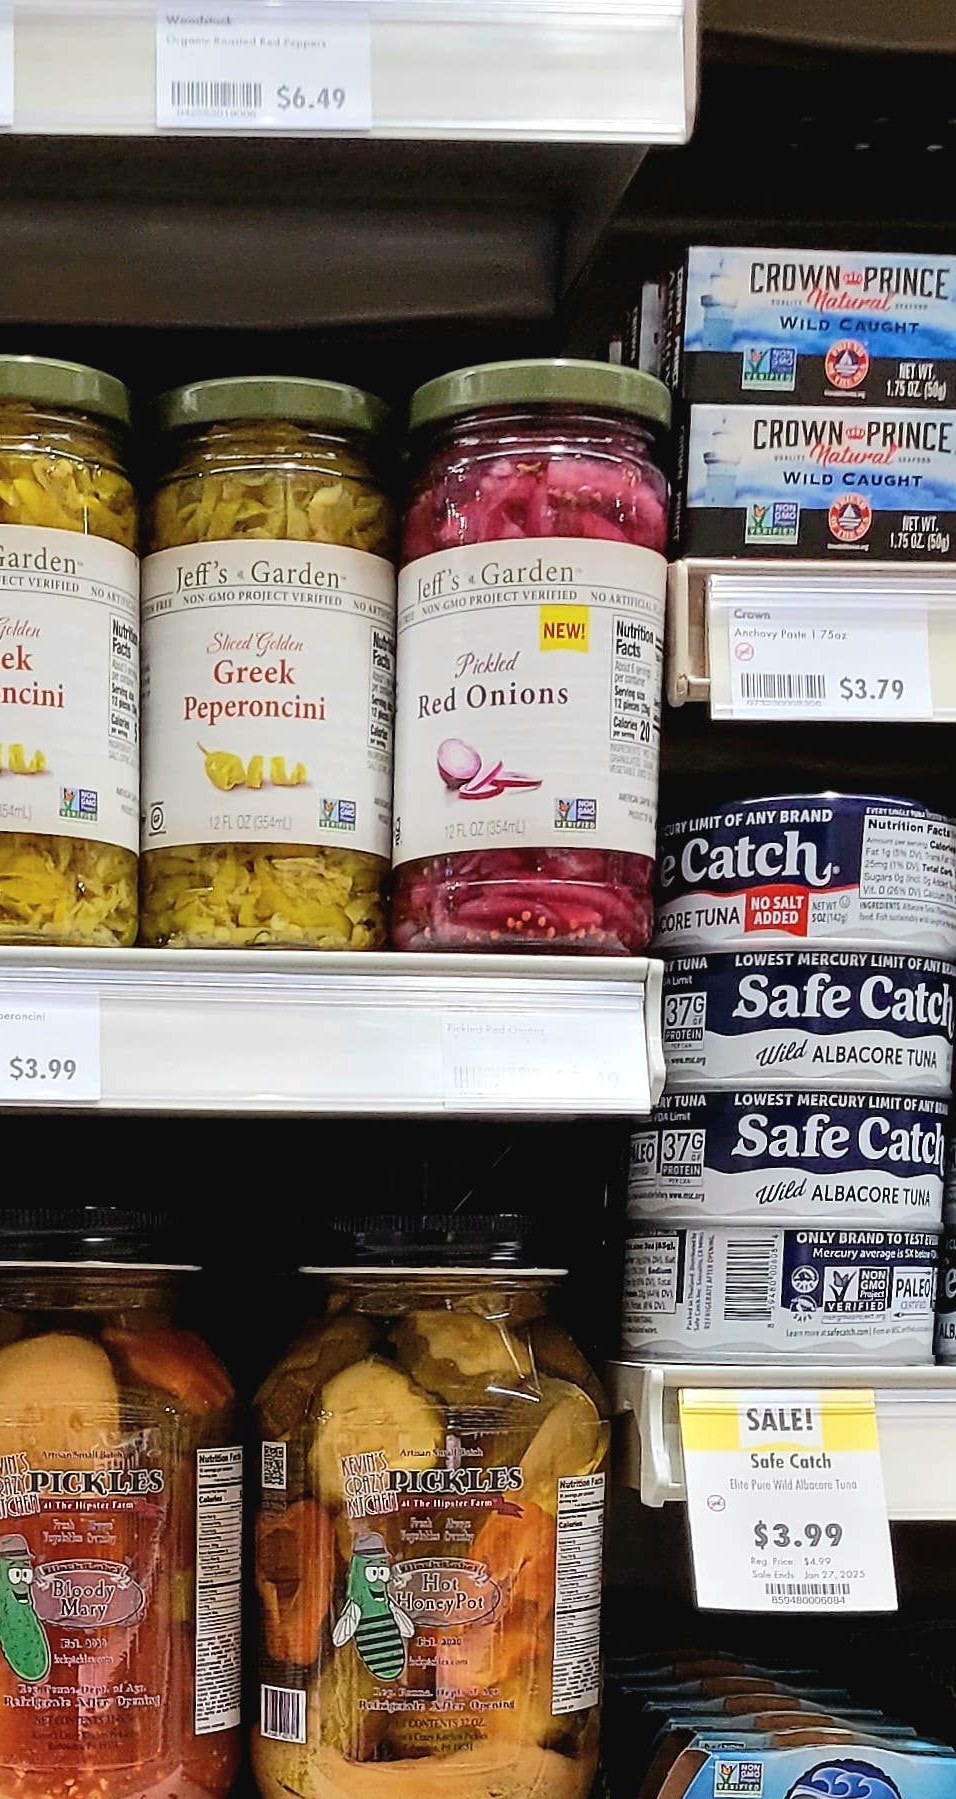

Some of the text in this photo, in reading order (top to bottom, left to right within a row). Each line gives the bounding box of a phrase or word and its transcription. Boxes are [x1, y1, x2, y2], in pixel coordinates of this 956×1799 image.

[277, 86, 346, 110] $6.49
[750, 262, 949, 300] CROWN PRINCE
[780, 316, 919, 334] WILD CAUGHT
[754, 420, 951, 453] CROWN PRINCE
[783, 471, 922, 488] WILD CAUGHT
[734, 609, 771, 620] Crown
[543, 622, 586, 641] NEW!
[214, 660, 296, 684] Greek
[840, 678, 904, 701] $3.79
[418, 683, 568, 720] Red Onions
[751, 896, 804, 910] NO SALT
[695, 907, 740, 926] TUNA
[754, 911, 798, 924] ADDED
[756, 1039, 937, 1068] Wild ALBACORE TUNA
[9, 1056, 76, 1080] $3.99
[732, 1114, 849, 1157] Safe
[756, 1178, 930, 1206] Wild ALBACORE TUNA
[897, 1280, 931, 1298] PALEO
[746, 1408, 813, 1432] SALE!
[751, 1454, 832, 1469] Safe Catch
[28, 1469, 164, 1494] PICKLES
[386, 1468, 523, 1494] PICKLES
[53, 1580, 115, 1600] Bloody
[423, 1573, 458, 1592] Hot
[60, 1600, 106, 1620] Mary
